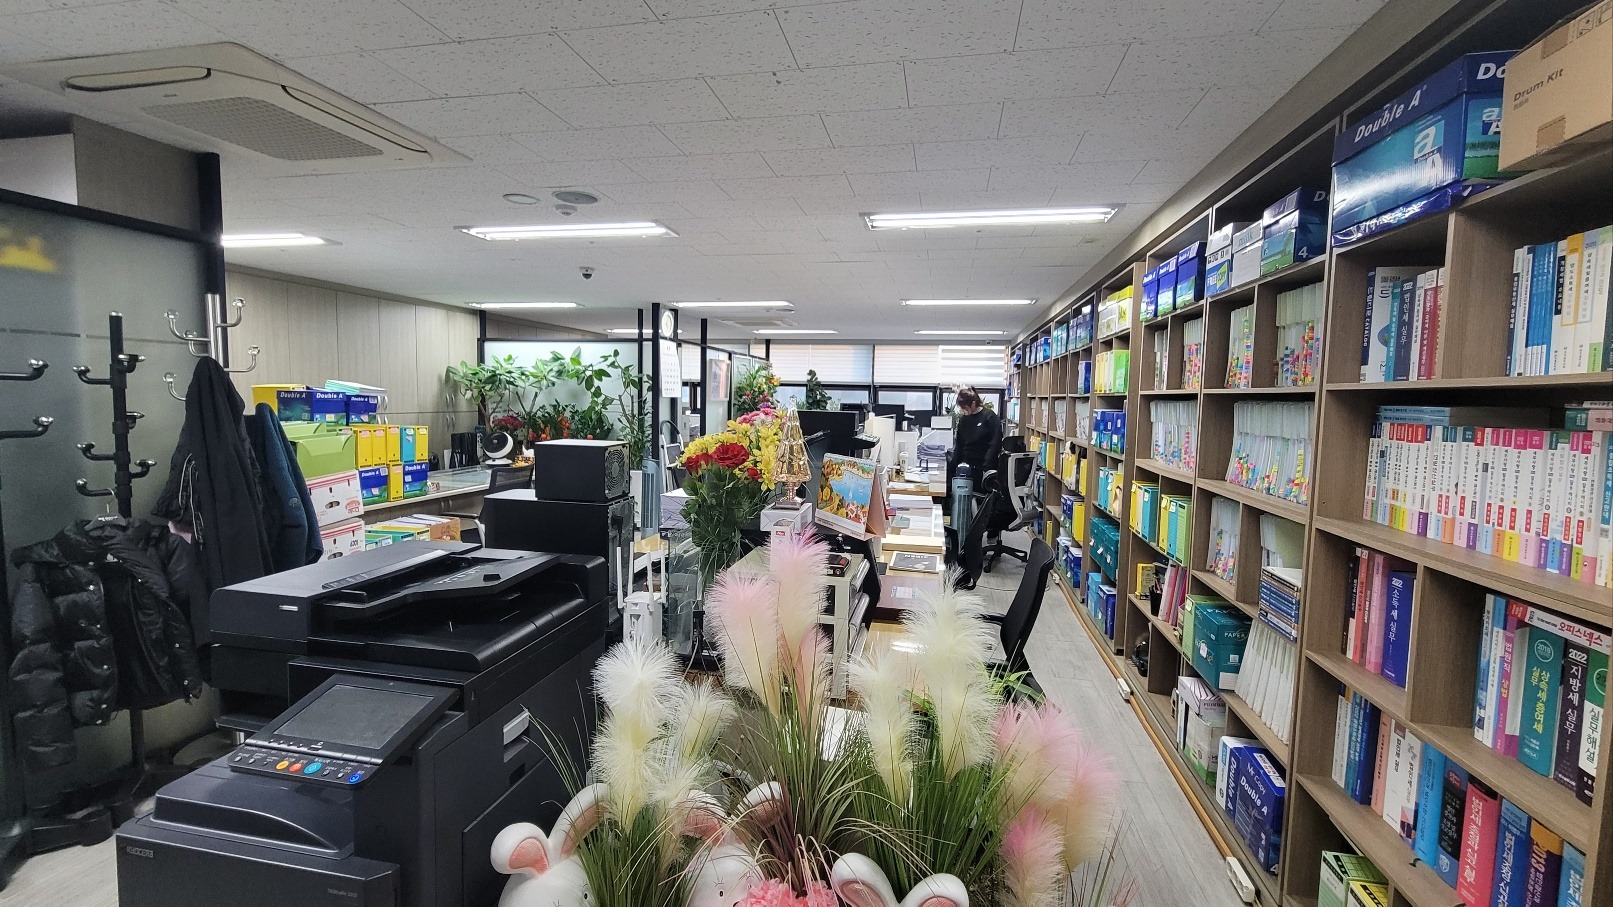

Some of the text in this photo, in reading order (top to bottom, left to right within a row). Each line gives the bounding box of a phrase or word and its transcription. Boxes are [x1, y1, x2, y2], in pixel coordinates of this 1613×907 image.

[1513, 68, 1564, 102] Drum Kit
[1354, 100, 1404, 142] Double
[1388, 590, 1400, 642] 소득세 실무
[1558, 621, 1603, 646] 오피스넥스
[1531, 666, 1540, 686] 실무
[1564, 665, 1582, 734] 지방세 실무
[1585, 708, 1600, 764] 실무해설
[1228, 757, 1237, 798] Double
[1240, 776, 1268, 816] Double A
[1470, 797, 1483, 826] 법인세
[127, 846, 154, 858] KYOCERA
